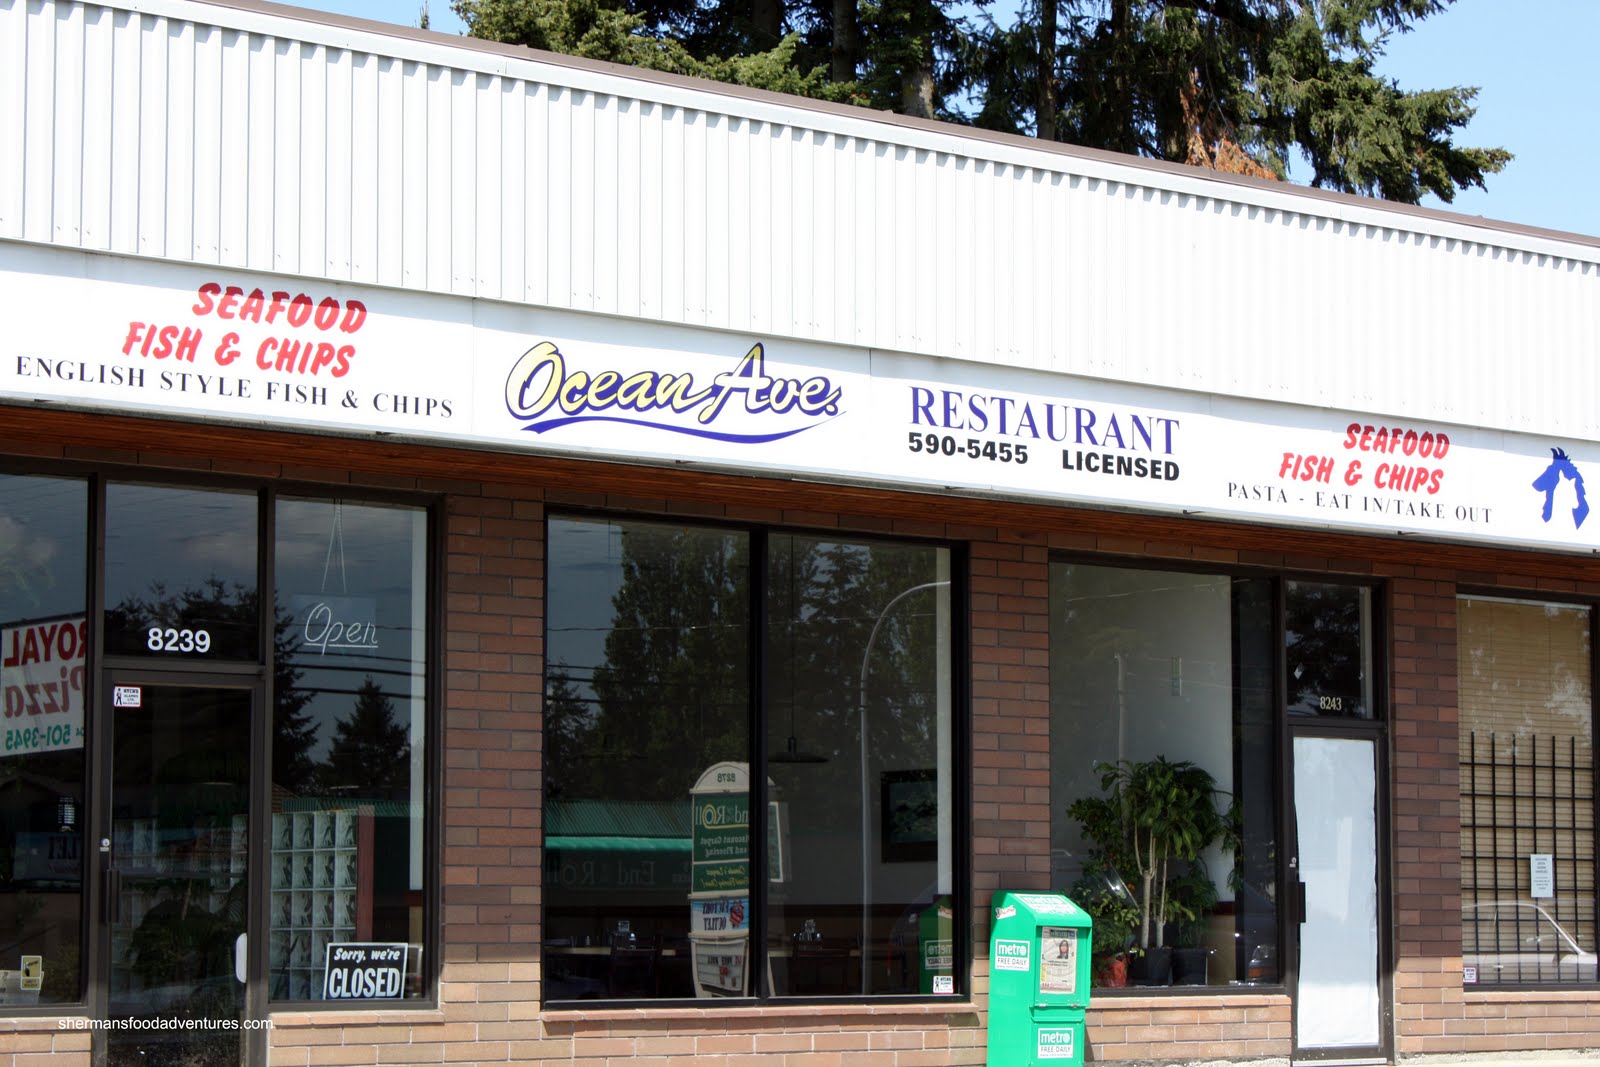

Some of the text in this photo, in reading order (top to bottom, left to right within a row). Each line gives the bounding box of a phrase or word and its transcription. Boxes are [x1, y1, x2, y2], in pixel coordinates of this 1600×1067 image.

[192, 282, 367, 333] SEAFOOD
[122, 321, 356, 378] FISH & CHIPS
[16, 355, 453, 418] ENGLISH STYLE FISH & CHIPS
[505, 341, 843, 424] Ocean Ave.
[909, 386, 1180, 455] RESTAURANT
[908, 432, 1180, 481] 590-5455 LICENSED
[1343, 423, 1450, 460] SEAFOOD
[1278, 452, 1444, 494] FISH & CHIPS
[1228, 482, 1288, 503] PASTA
[1316, 491, 1352, 510] EAT
[1364, 496, 1445, 519] IN/TAKE
[1455, 505, 1492, 523] OUT
[148, 627, 211, 653] 8239
[305, 603, 378, 655] Open
[1319, 696, 1342, 711] 8243
[334, 948, 400, 963] Sorry, we're
[997, 957, 1027, 966] FREE DAILY
[998, 943, 1027, 956] metro
[329, 967, 400, 998] CLOSED
[1041, 1032, 1070, 1043] metro
